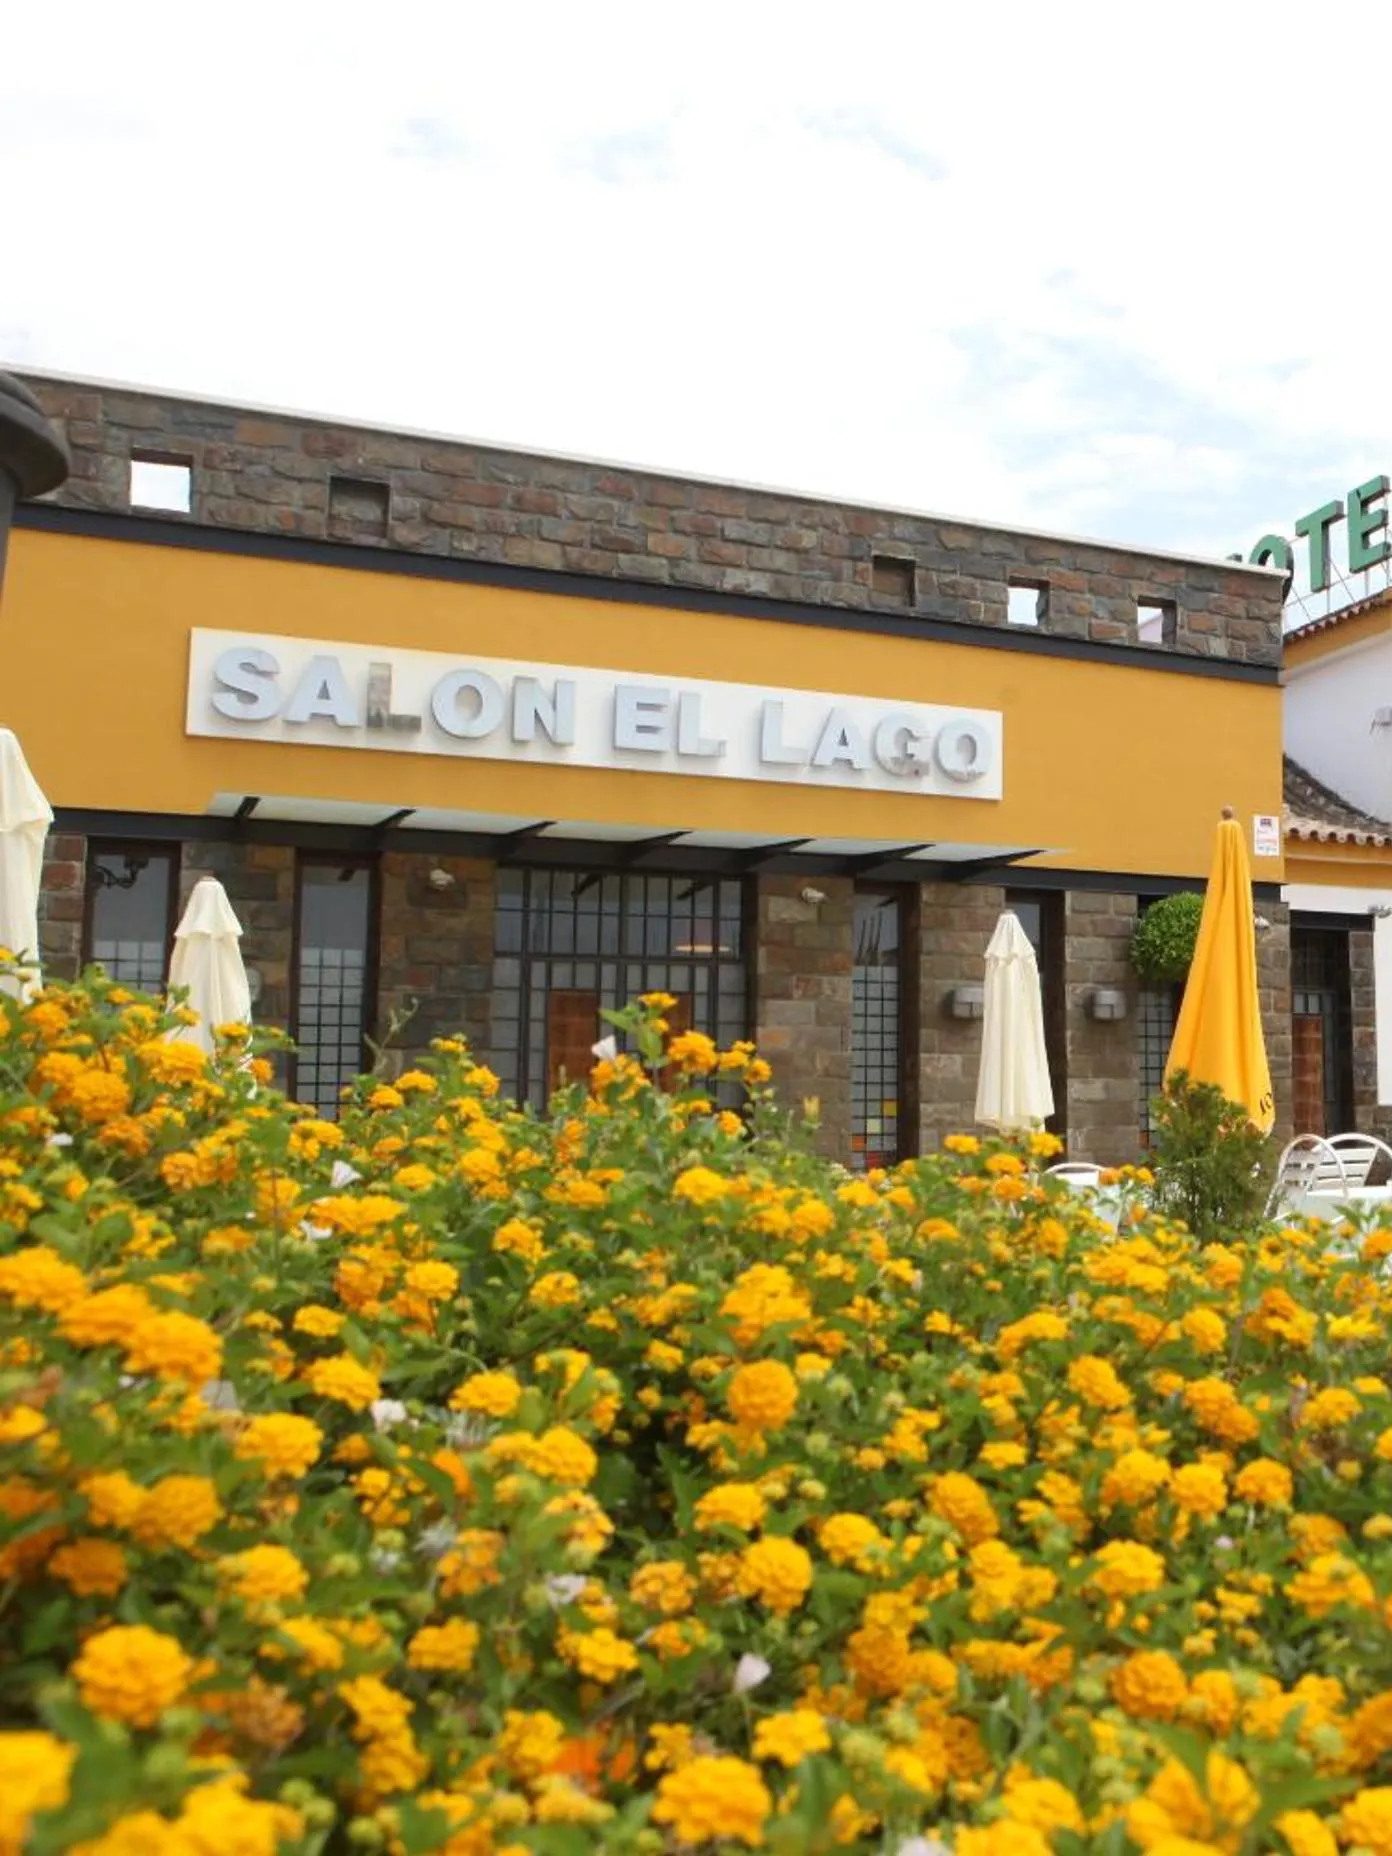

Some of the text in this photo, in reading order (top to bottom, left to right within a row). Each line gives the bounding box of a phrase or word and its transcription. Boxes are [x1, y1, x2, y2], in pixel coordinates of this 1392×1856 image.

[211, 646, 993, 784] SALON EL LAGO
